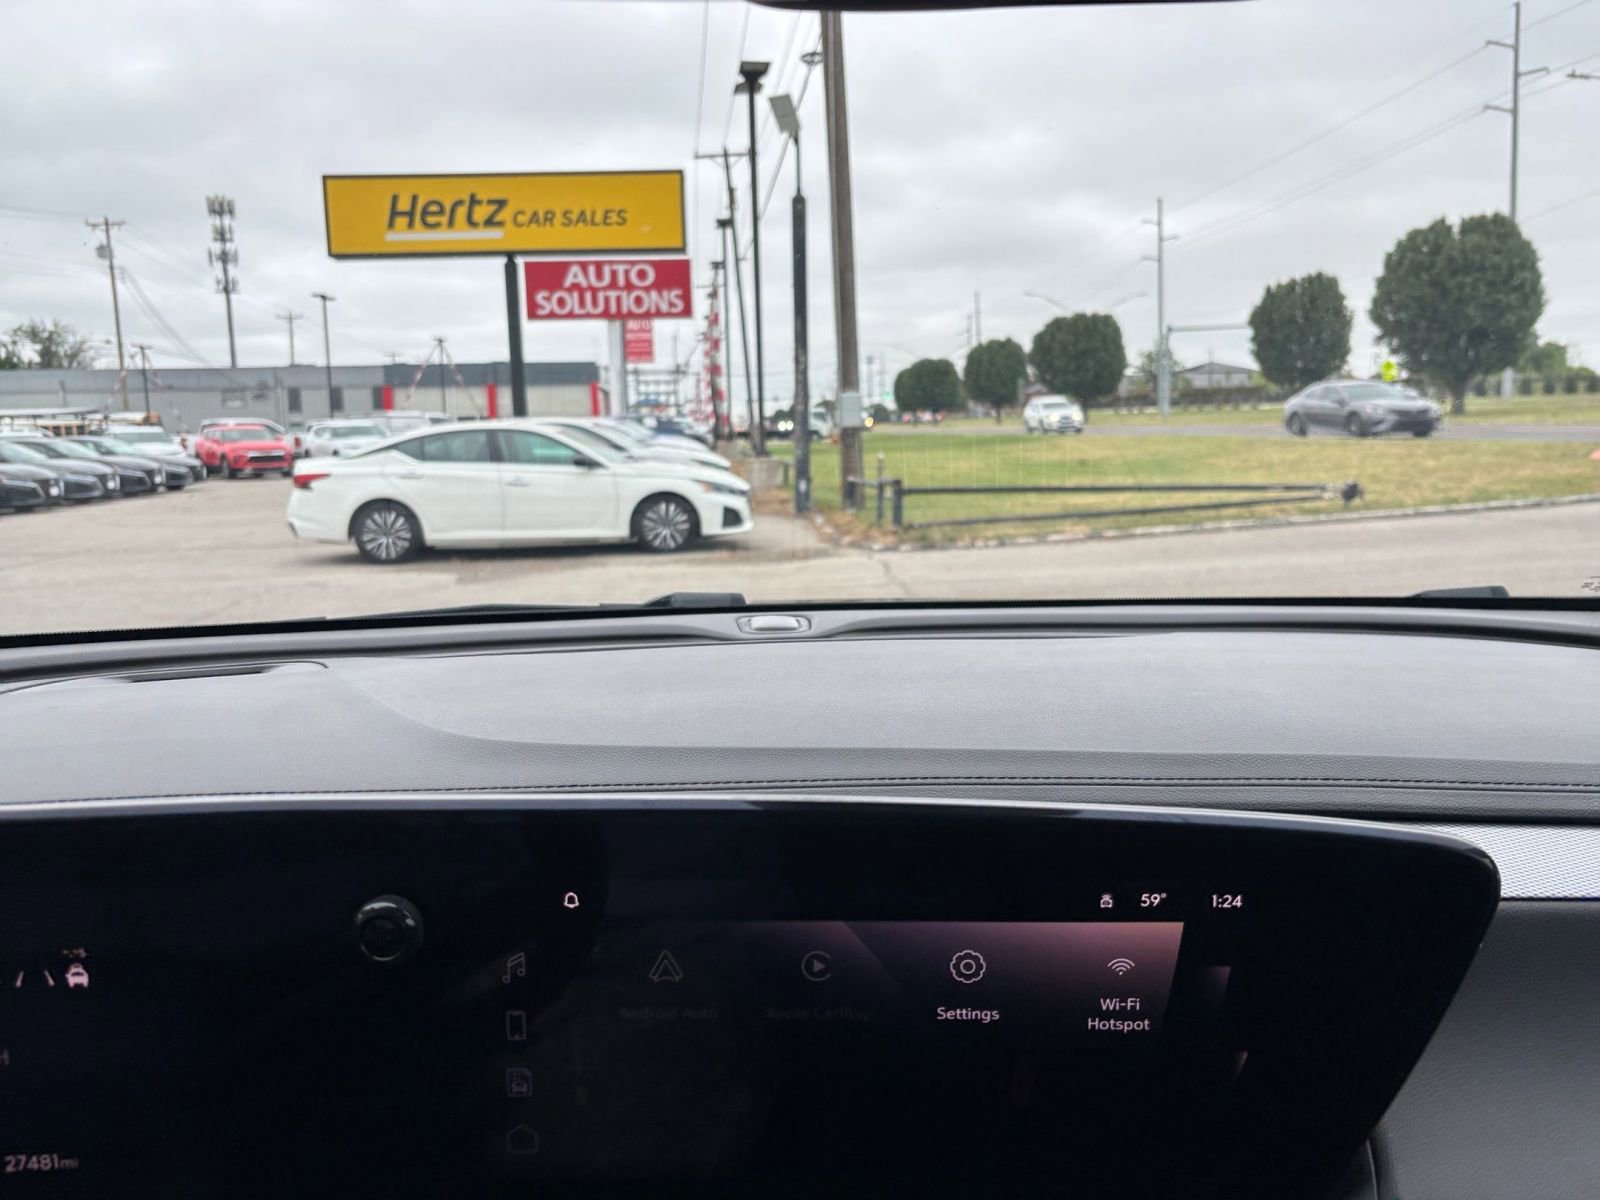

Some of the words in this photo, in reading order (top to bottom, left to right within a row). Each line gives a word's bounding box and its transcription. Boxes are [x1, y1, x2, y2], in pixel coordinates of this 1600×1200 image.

[387, 193, 509, 231] Hertz
[512, 210, 556, 228] CAR
[560, 209, 628, 228] SALES
[563, 263, 656, 288] AUTO
[534, 289, 685, 316] SOLUTIONS
[1140, 893, 1167, 908] 59°
[1211, 894, 1243, 909] 1:24
[1099, 997, 1141, 1011] Wi-Fi
[936, 1006, 1001, 1024] Settings
[1087, 1017, 1150, 1034] Hotspot
